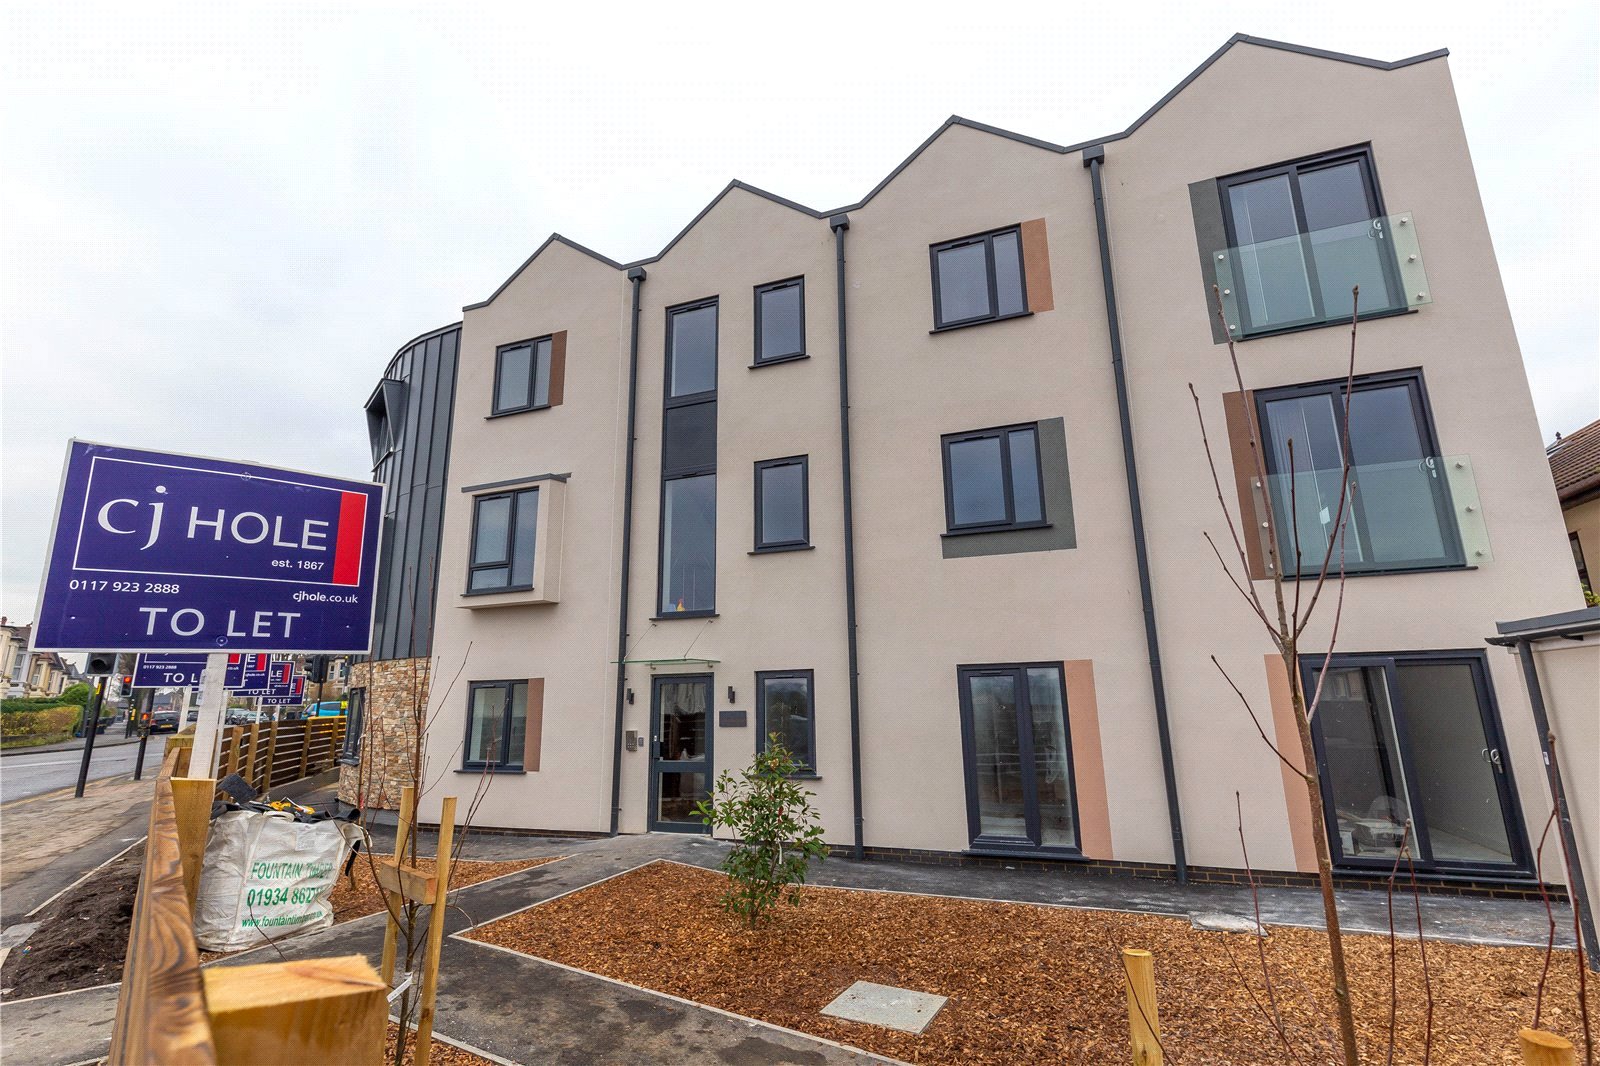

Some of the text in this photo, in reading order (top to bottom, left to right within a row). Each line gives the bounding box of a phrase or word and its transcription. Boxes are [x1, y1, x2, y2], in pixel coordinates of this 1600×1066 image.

[97, 485, 329, 551] cj HOLE
[271, 559, 325, 571] est. 1867
[69, 579, 180, 595] 0117 923 2888
[292, 590, 359, 604] cjhole.co.uk
[139, 607, 301, 639] TO LET
[164, 672, 184, 682] TO
[250, 862, 304, 879] FOUNTAIN
[246, 887, 289, 907] 01934
